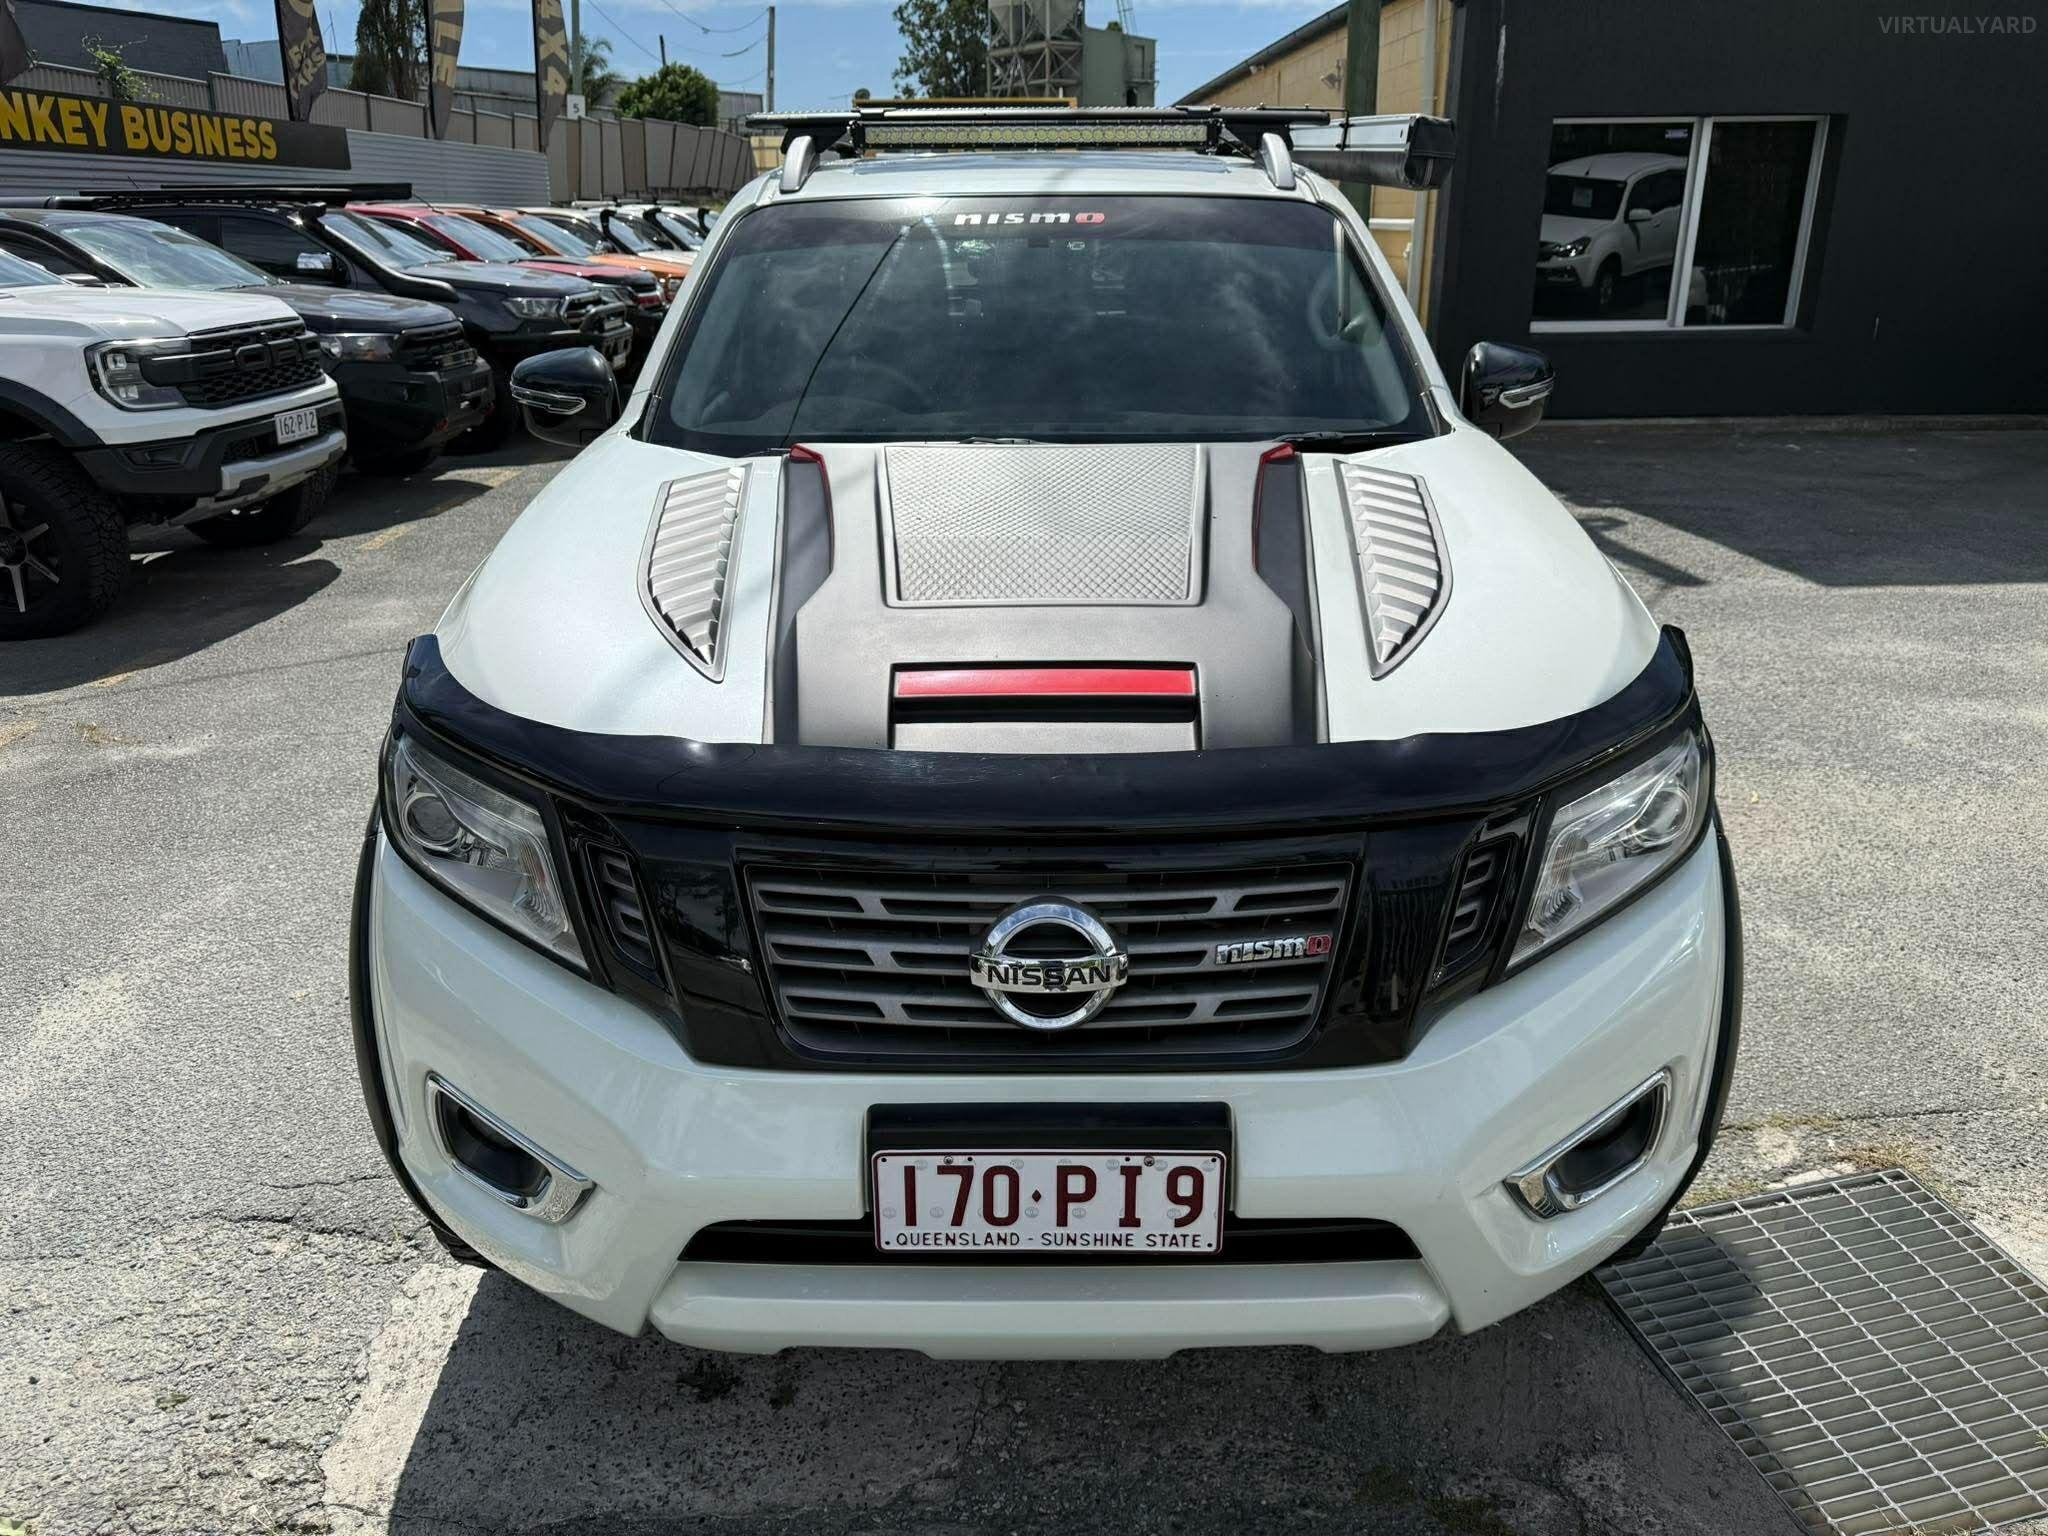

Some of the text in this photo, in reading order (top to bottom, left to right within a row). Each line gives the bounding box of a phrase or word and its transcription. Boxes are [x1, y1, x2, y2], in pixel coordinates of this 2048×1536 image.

[572, 103, 580, 114] 5
[120, 105, 278, 160] BUSINESS
[987, 964, 1111, 987] NISSAN
[896, 1232, 1021, 1247] QUEENSLAND
[1041, 1232, 1135, 1248] SUNSHINE
[1145, 1232, 1202, 1248] STATE
